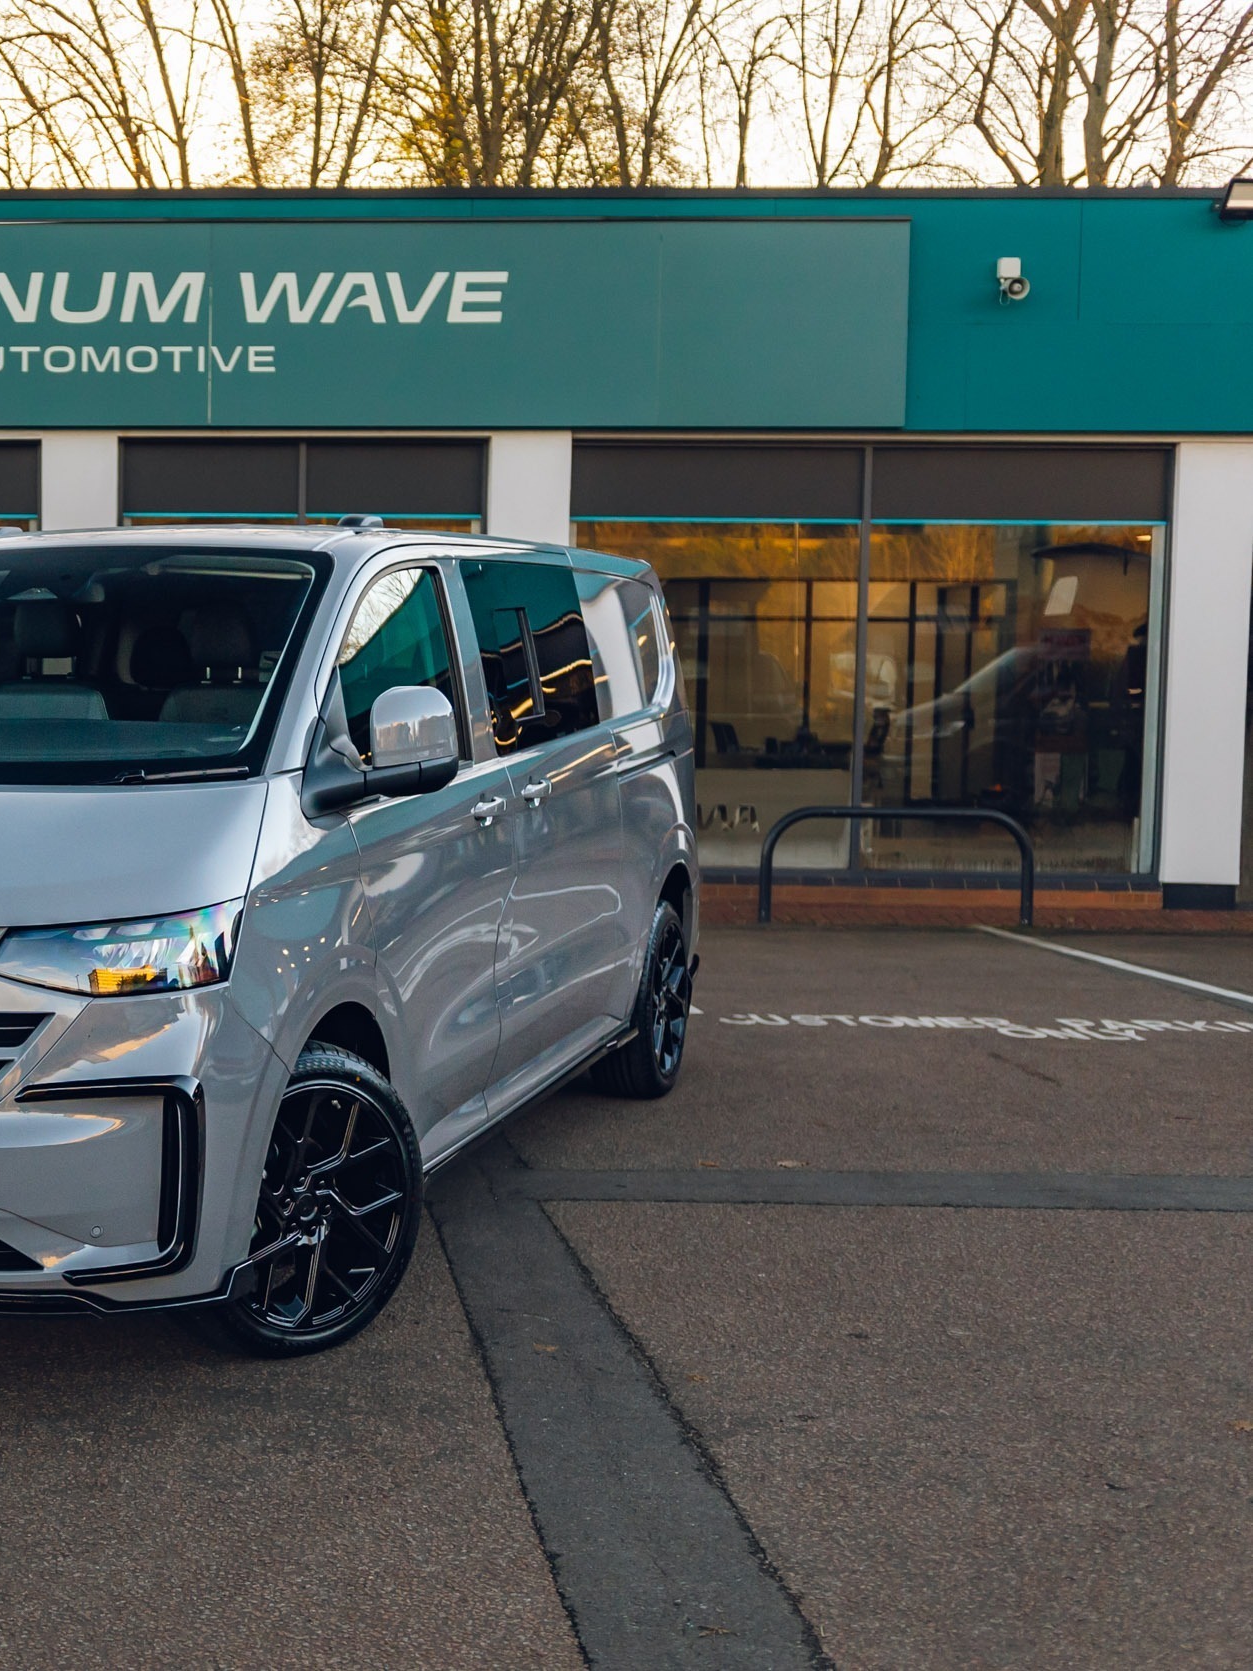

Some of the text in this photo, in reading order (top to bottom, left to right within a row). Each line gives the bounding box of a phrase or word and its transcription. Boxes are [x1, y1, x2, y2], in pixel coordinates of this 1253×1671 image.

[239, 271, 510, 324] WAVE
[719, 1013, 1029, 1030] CUSTOMER
[997, 1026, 1147, 1041] ONLY
